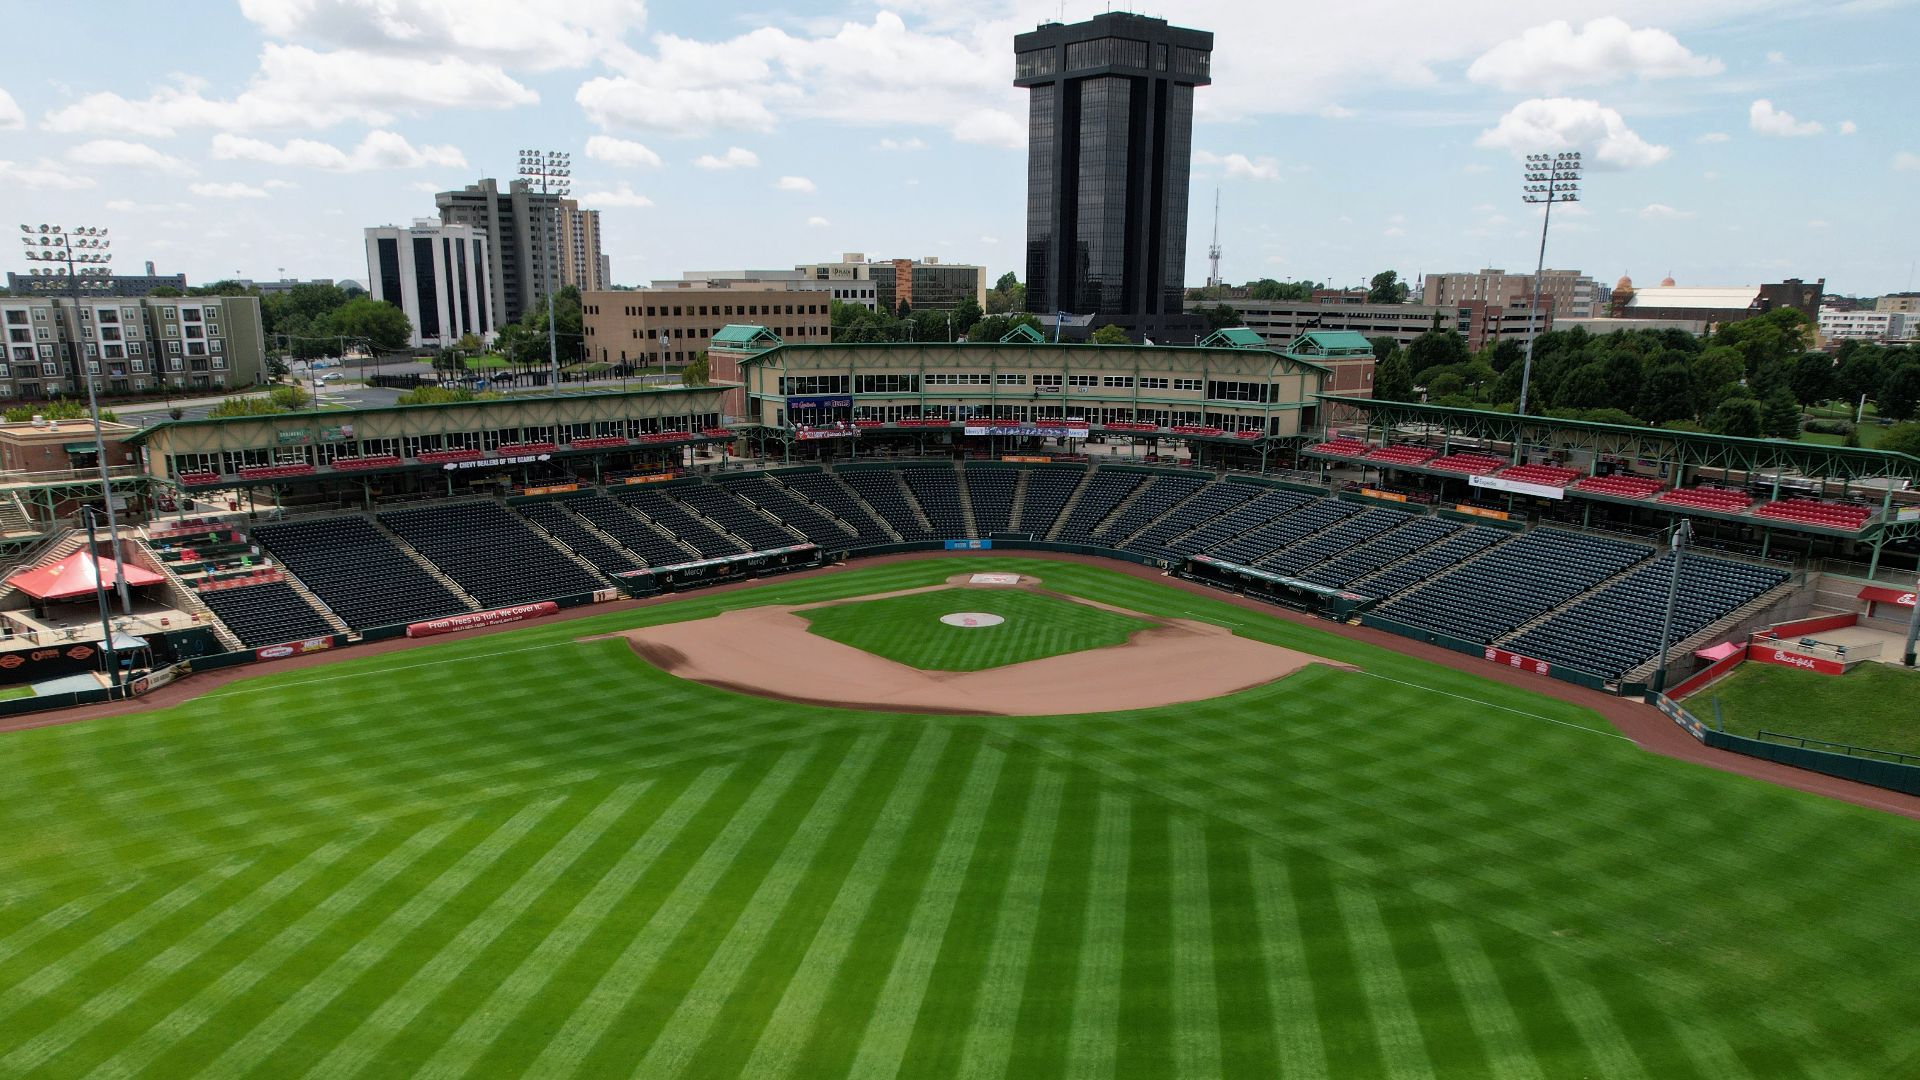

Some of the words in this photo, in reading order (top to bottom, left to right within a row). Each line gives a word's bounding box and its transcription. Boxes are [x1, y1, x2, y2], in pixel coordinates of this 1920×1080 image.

[459, 461, 476, 469] CHEVY
[477, 459, 499, 467] DEALERS
[517, 455, 536, 463] OZARKS
[747, 558, 766, 567] Mercy
[684, 567, 703, 577] Mercy
[428, 620, 450, 629] From
[450, 617, 472, 626] Trees
[472, 614, 481, 622] to
[481, 611, 500, 621] Turf.
[500, 609, 512, 617] We
[512, 605, 532, 616] Cover
